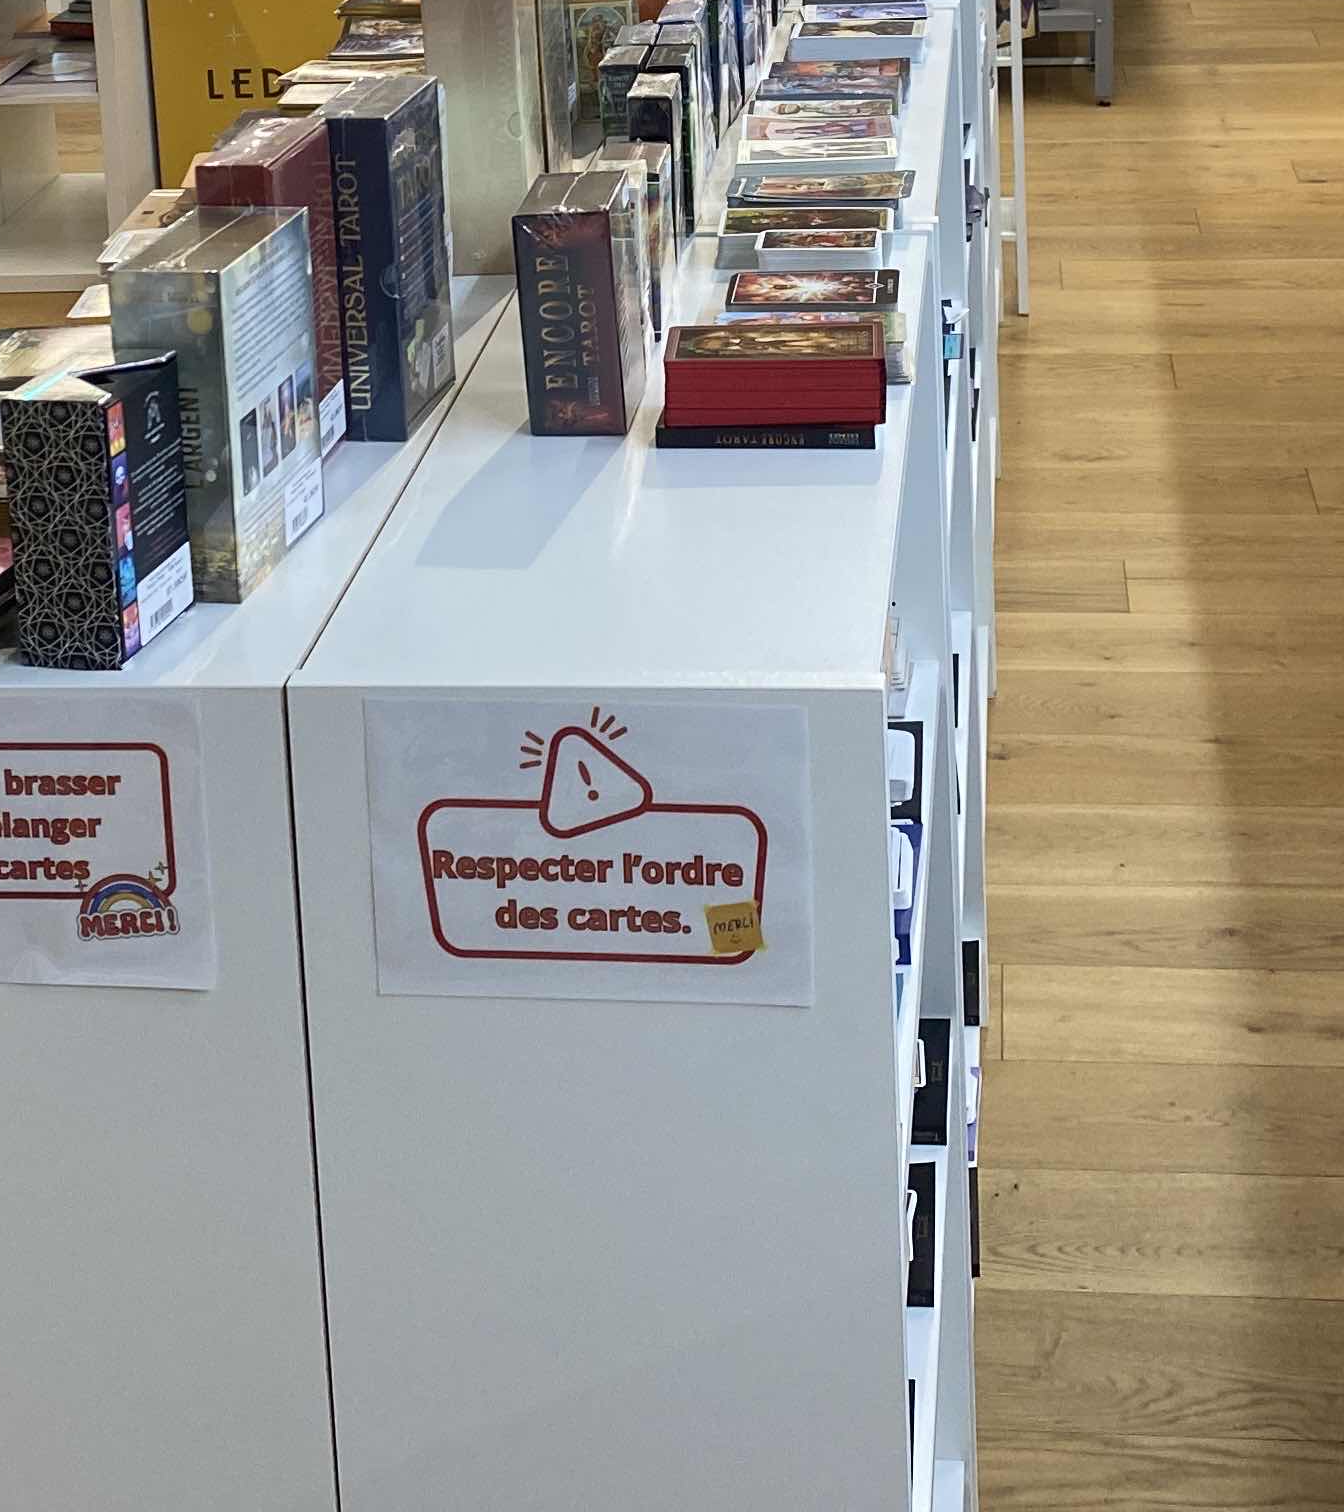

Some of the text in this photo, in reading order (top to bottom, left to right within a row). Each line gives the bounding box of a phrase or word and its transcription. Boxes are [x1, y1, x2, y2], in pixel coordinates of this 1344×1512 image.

[335, 153, 372, 411] UNIVERSAL TAROT
[535, 254, 579, 391] ENCORE
[576, 284, 601, 367] TAROT
[4, 769, 121, 796] brasser
[432, 849, 744, 888] Respecter l'ordre
[495, 899, 692, 934] des cartes.
[712, 918, 755, 936] MERCI
